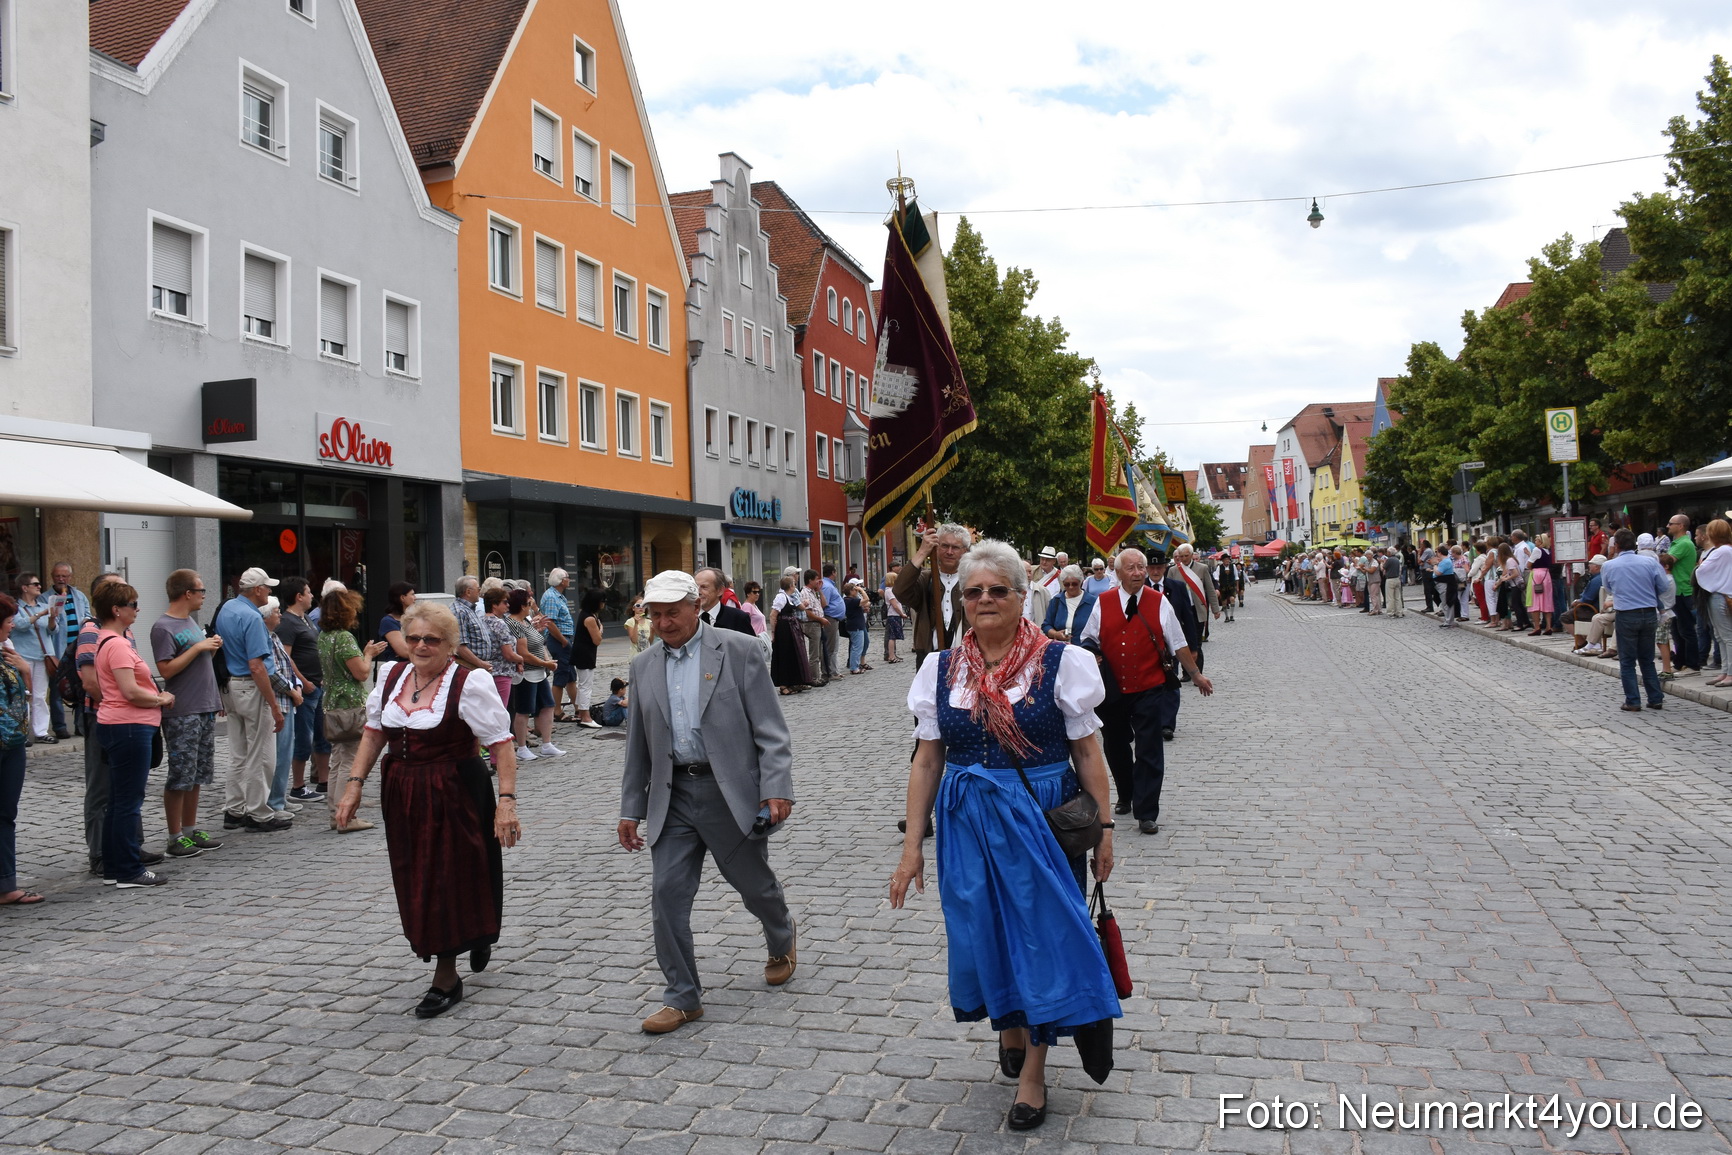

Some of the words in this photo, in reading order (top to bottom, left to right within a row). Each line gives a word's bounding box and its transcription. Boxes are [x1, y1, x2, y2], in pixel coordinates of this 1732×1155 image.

[207, 417, 246, 436] s.Oliver
[1556, 416, 1567, 428] H
[319, 416, 394, 467] s.Oliver
[141, 520, 149, 529] 29
